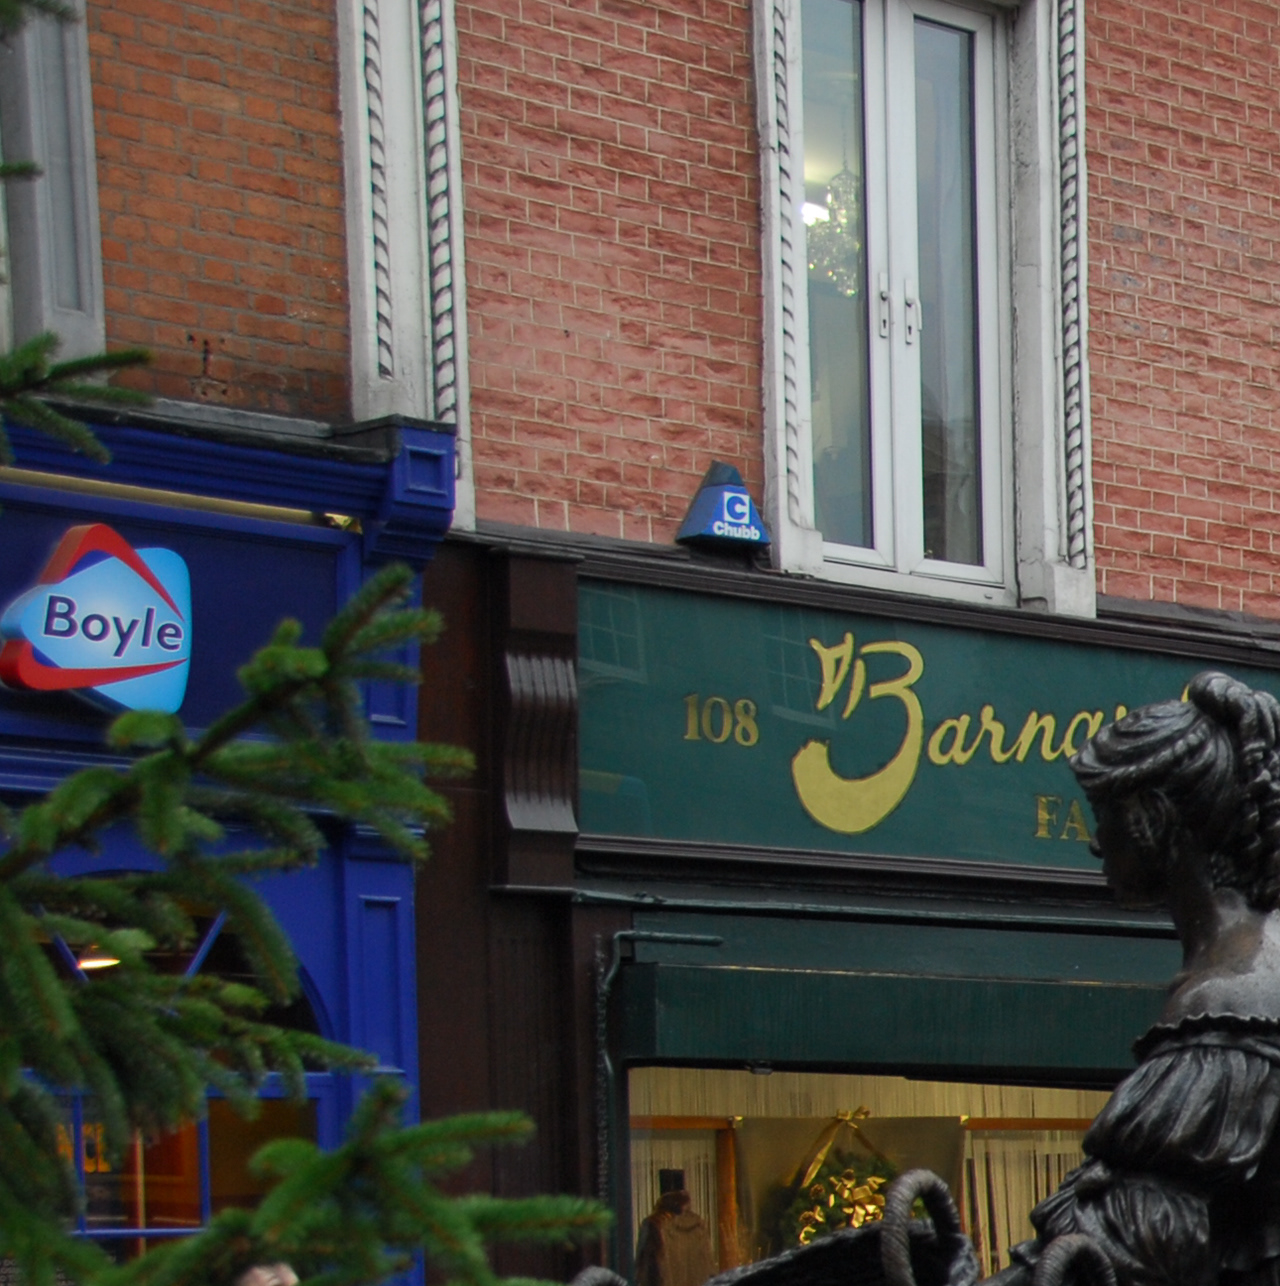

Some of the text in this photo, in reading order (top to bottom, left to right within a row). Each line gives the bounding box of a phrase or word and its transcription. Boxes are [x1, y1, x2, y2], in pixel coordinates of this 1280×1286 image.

[712, 520, 762, 543] Chubb
[43, 593, 184, 657] Boyle
[683, 693, 760, 747] 108
[791, 632, 1128, 835] Barna
